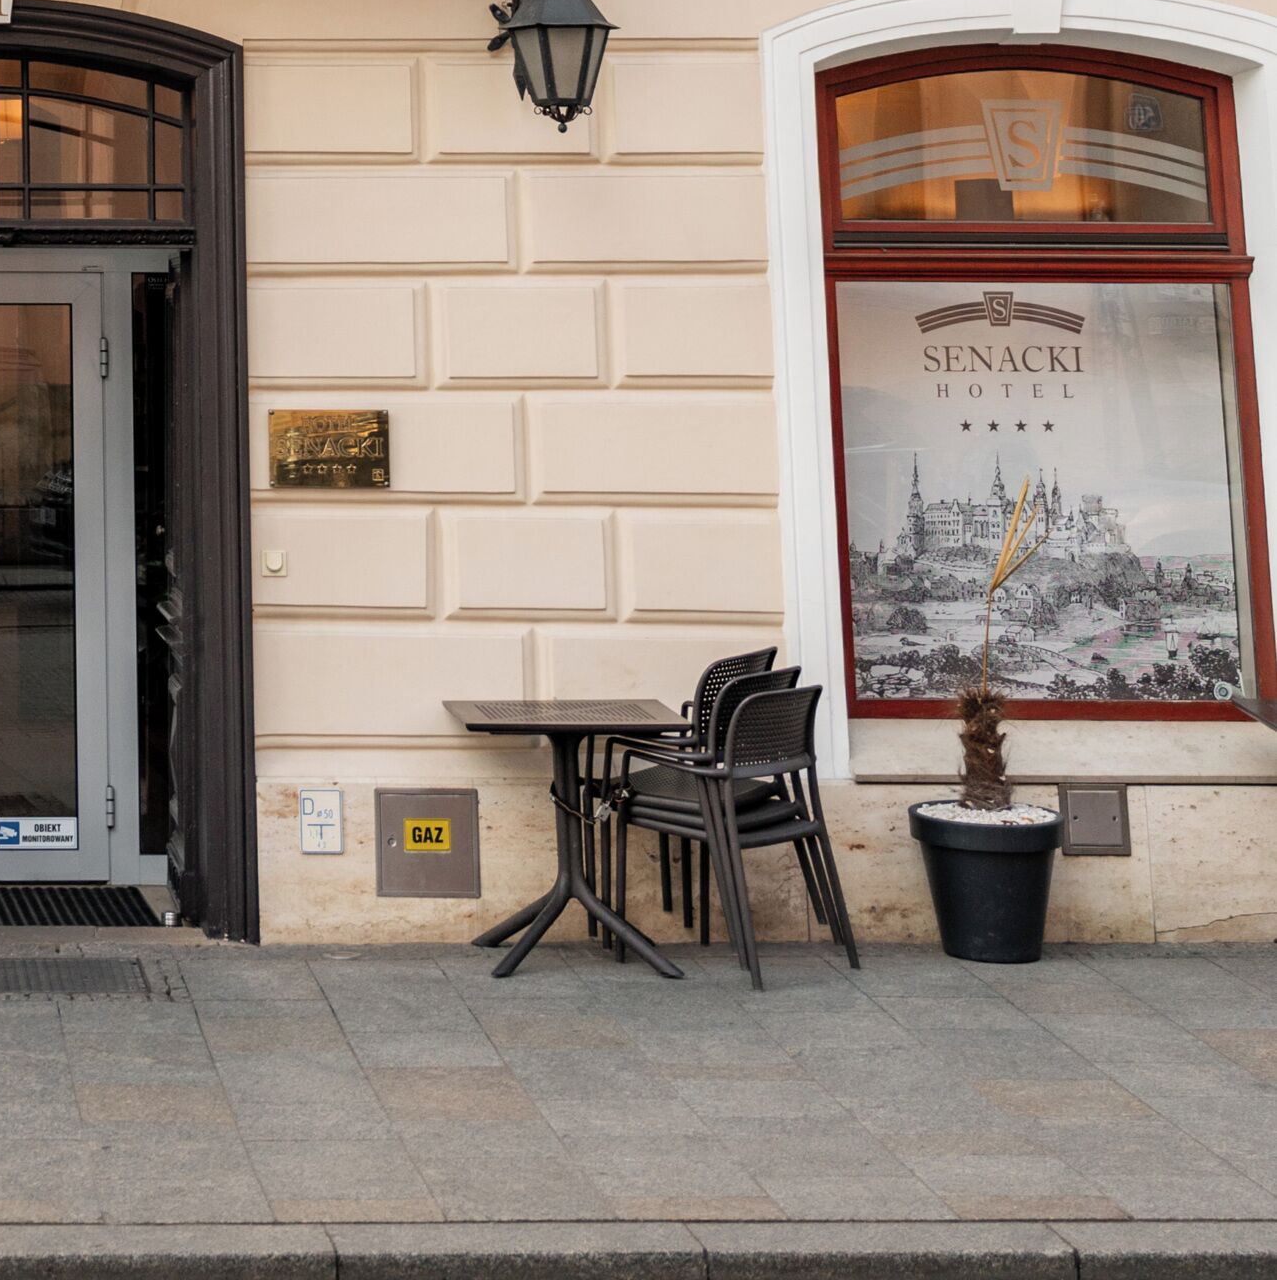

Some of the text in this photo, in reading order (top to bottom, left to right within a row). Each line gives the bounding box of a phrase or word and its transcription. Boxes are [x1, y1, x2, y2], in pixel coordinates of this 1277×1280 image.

[1007, 120, 1043, 171] S
[992, 298, 1006, 319] S
[923, 344, 1085, 373] SENACKI
[936, 382, 1075, 400] HOTEL
[275, 433, 385, 458] SENACKI
[302, 797, 315, 815] D
[34, 823, 61, 832] OBIEKT
[411, 826, 444, 843] GAZ
[22, 835, 73, 843] MONITOROWANY
